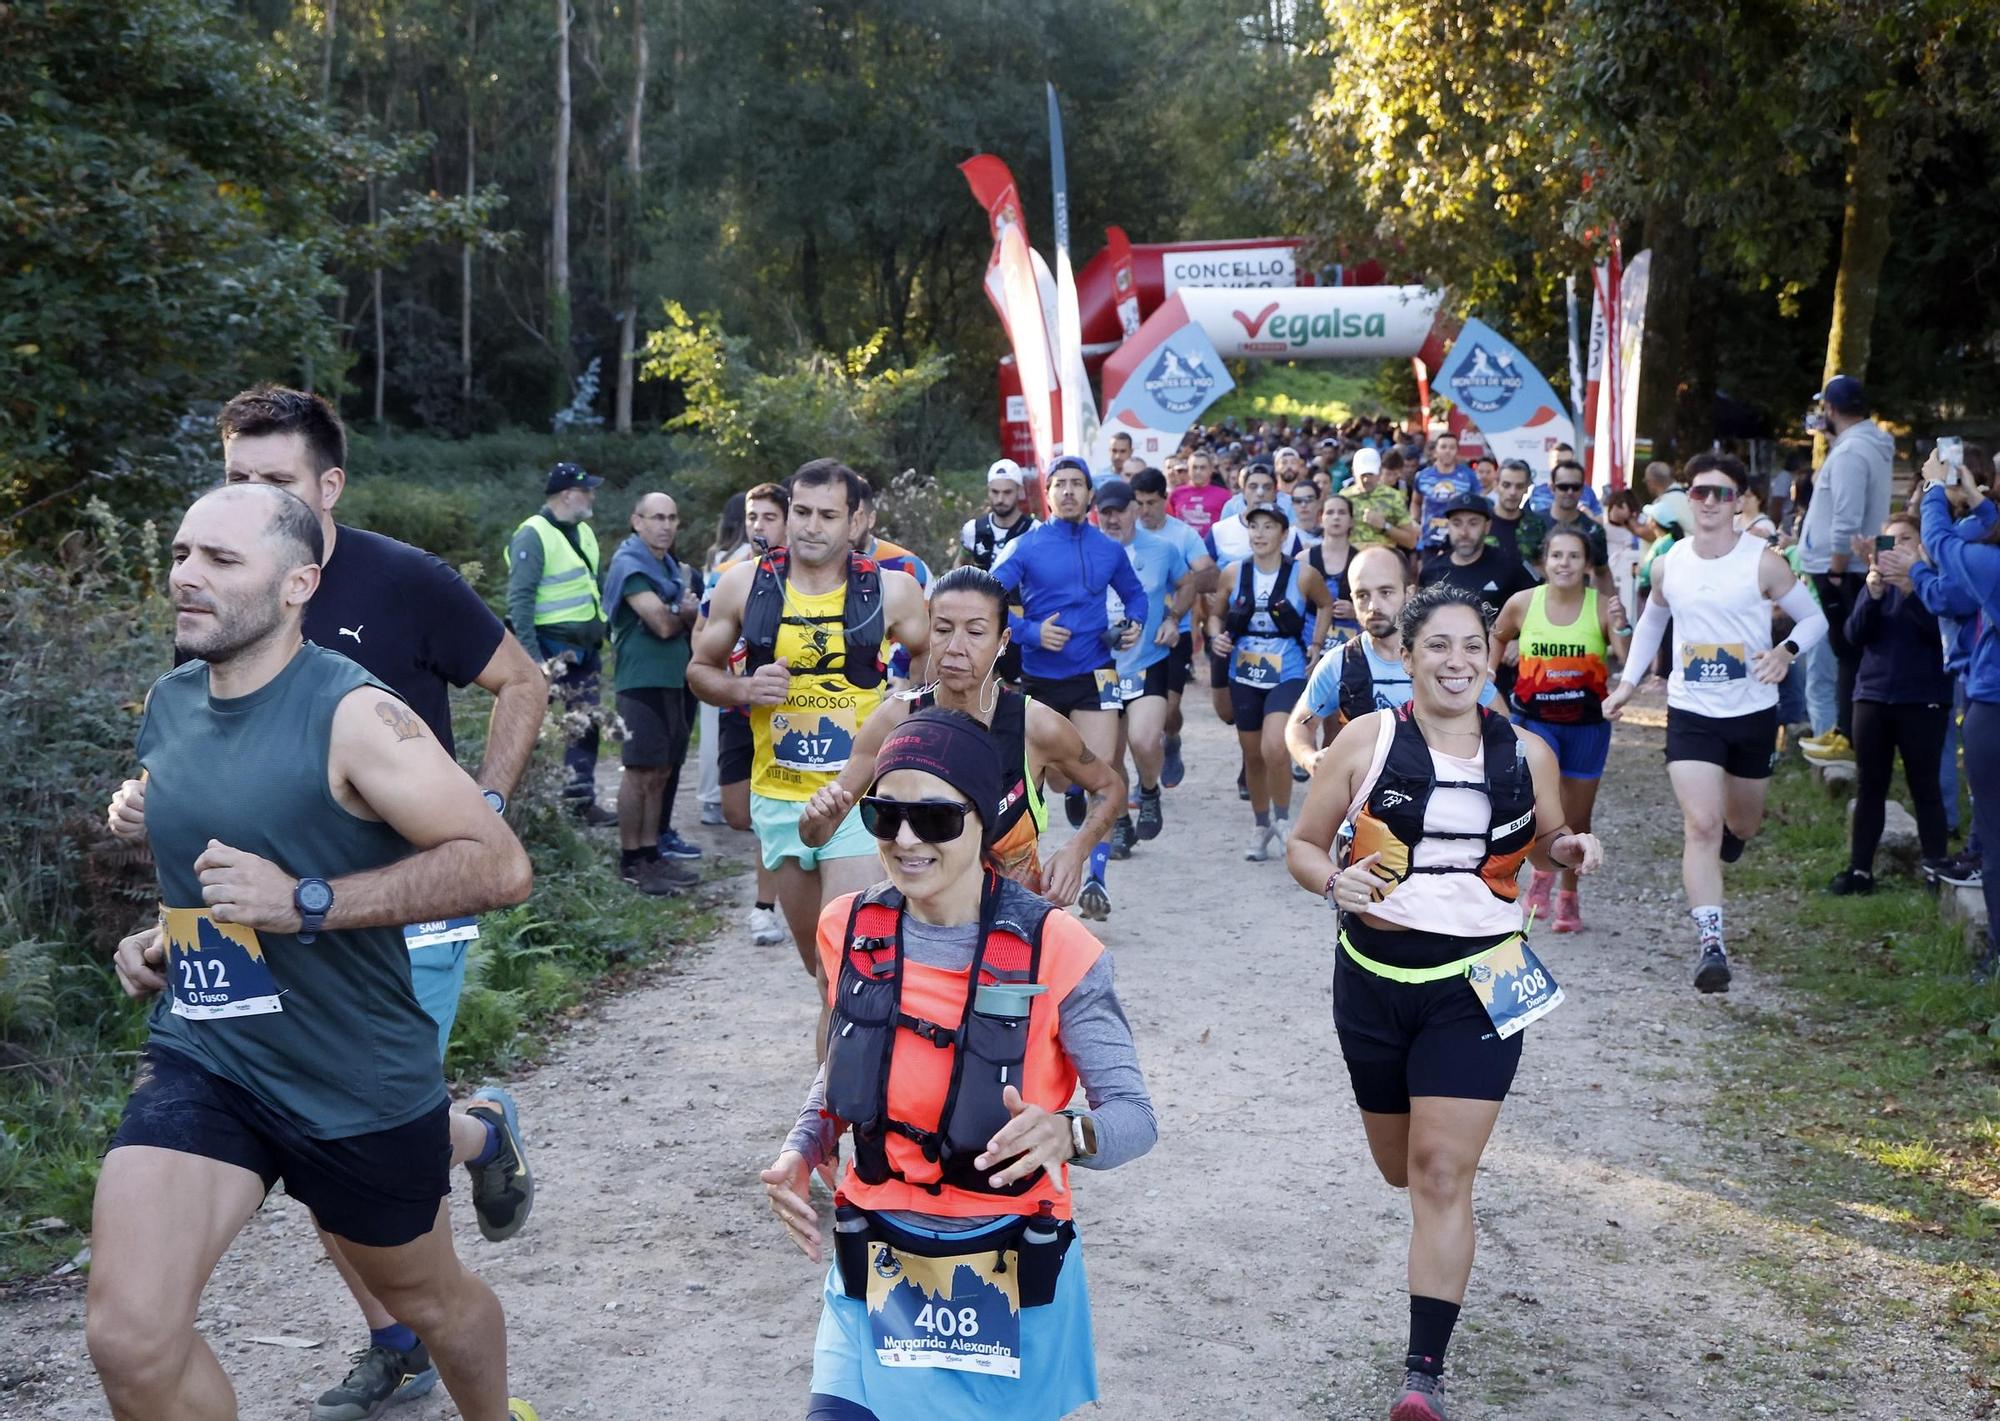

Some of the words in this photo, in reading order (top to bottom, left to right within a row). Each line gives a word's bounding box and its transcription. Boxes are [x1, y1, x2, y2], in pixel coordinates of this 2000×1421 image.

[1174, 260, 1285, 280] CONCELLO
[1231, 301, 1385, 347] Vegalsa
[1531, 642, 1586, 658] 3NORTH
[1247, 666, 1267, 679] 287
[1700, 663, 1728, 677] 322
[797, 738, 833, 756] 317
[808, 755, 825, 764] Kyto
[419, 920, 447, 934] SAMU
[179, 959, 231, 989] 212
[1511, 967, 1548, 1004] 208
[188, 991, 199, 1003] O
[200, 991, 229, 1003] Fusco
[1525, 992, 1549, 1010] Diana
[914, 1303, 980, 1337] 408
[883, 1335, 947, 1352] Margarida
[950, 1338, 1011, 1357] Alexandra
